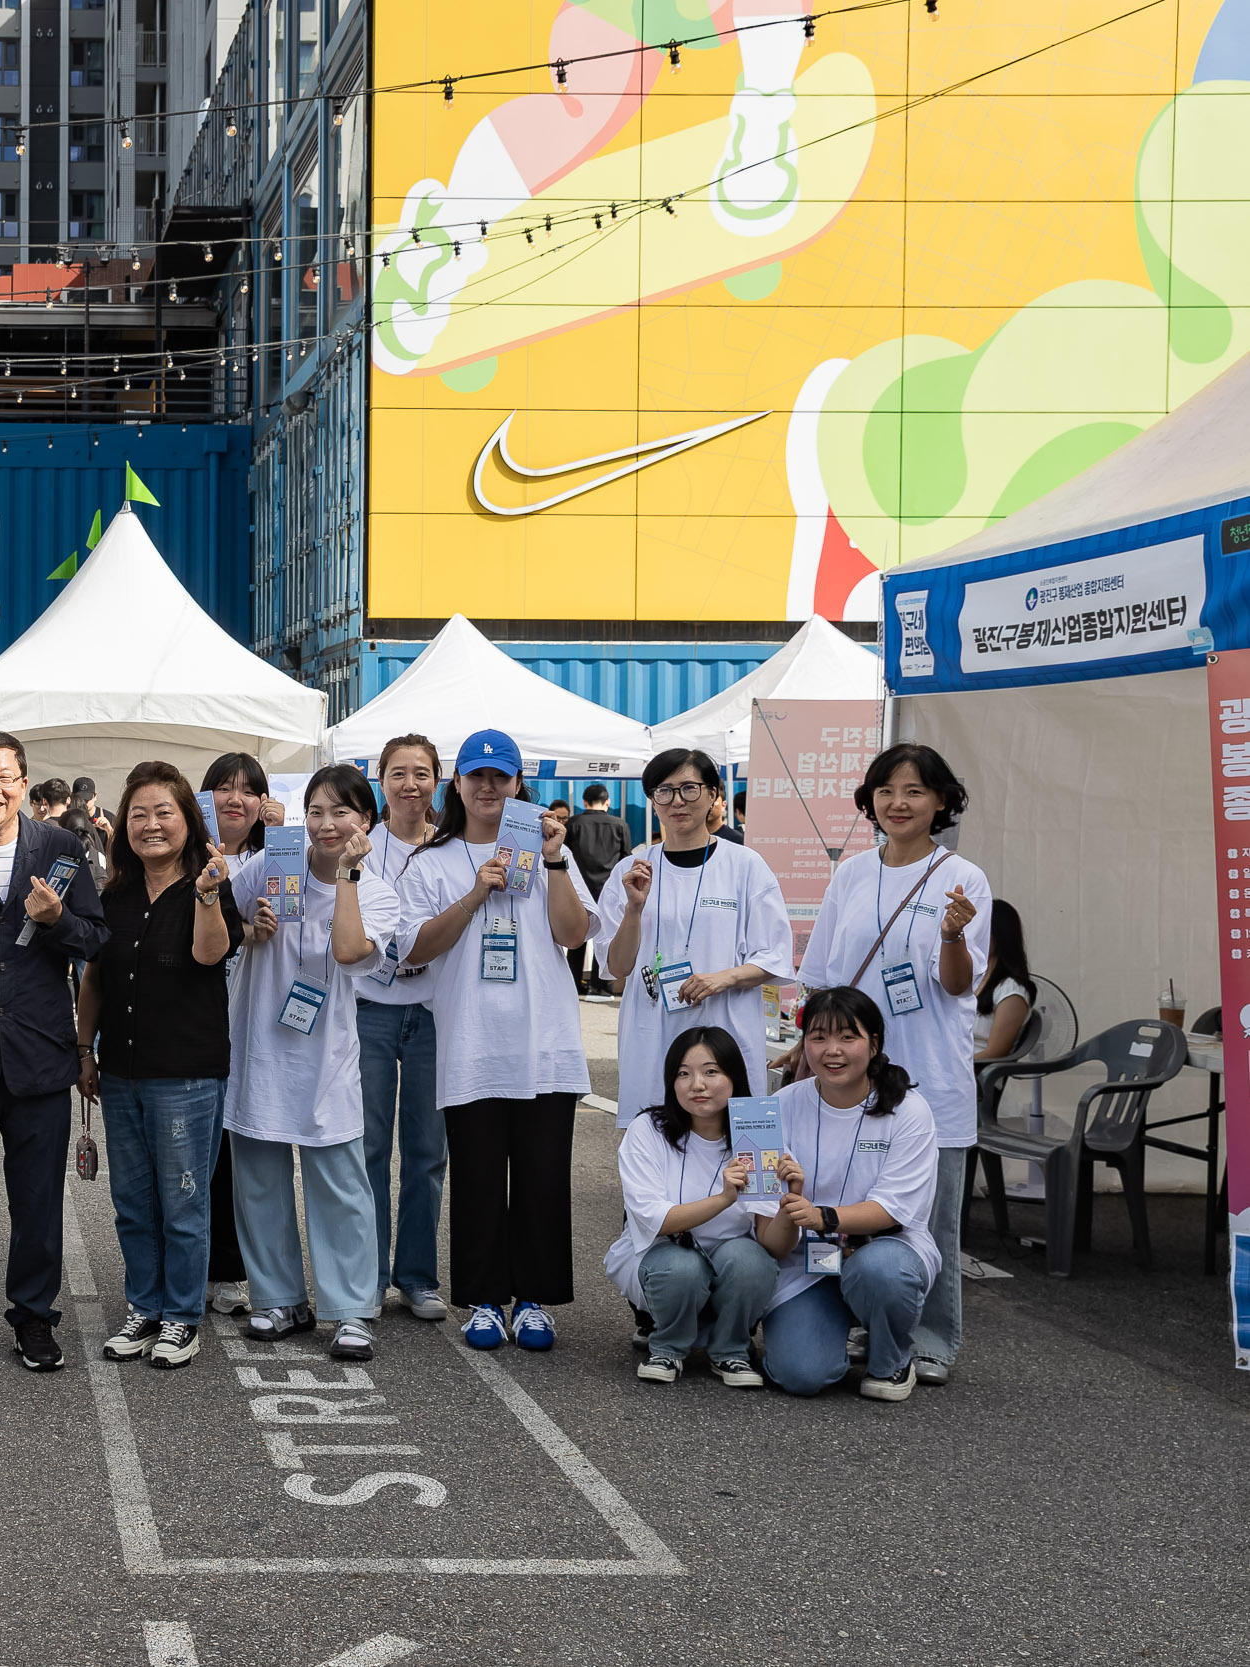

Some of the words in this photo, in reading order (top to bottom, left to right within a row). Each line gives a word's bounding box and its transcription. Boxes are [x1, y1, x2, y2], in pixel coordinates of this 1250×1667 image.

[1040, 588, 1058, 604] 광진구
[1058, 582, 1083, 600] 봉제산업
[1084, 574, 1125, 596] 종합지원센터
[972, 595, 1188, 653] 광진구봉제산업종합지원센터
[483, 743, 493, 755] LA
[288, 1012, 307, 1024] STAFF
[859, 1142, 878, 1150] 진구네
